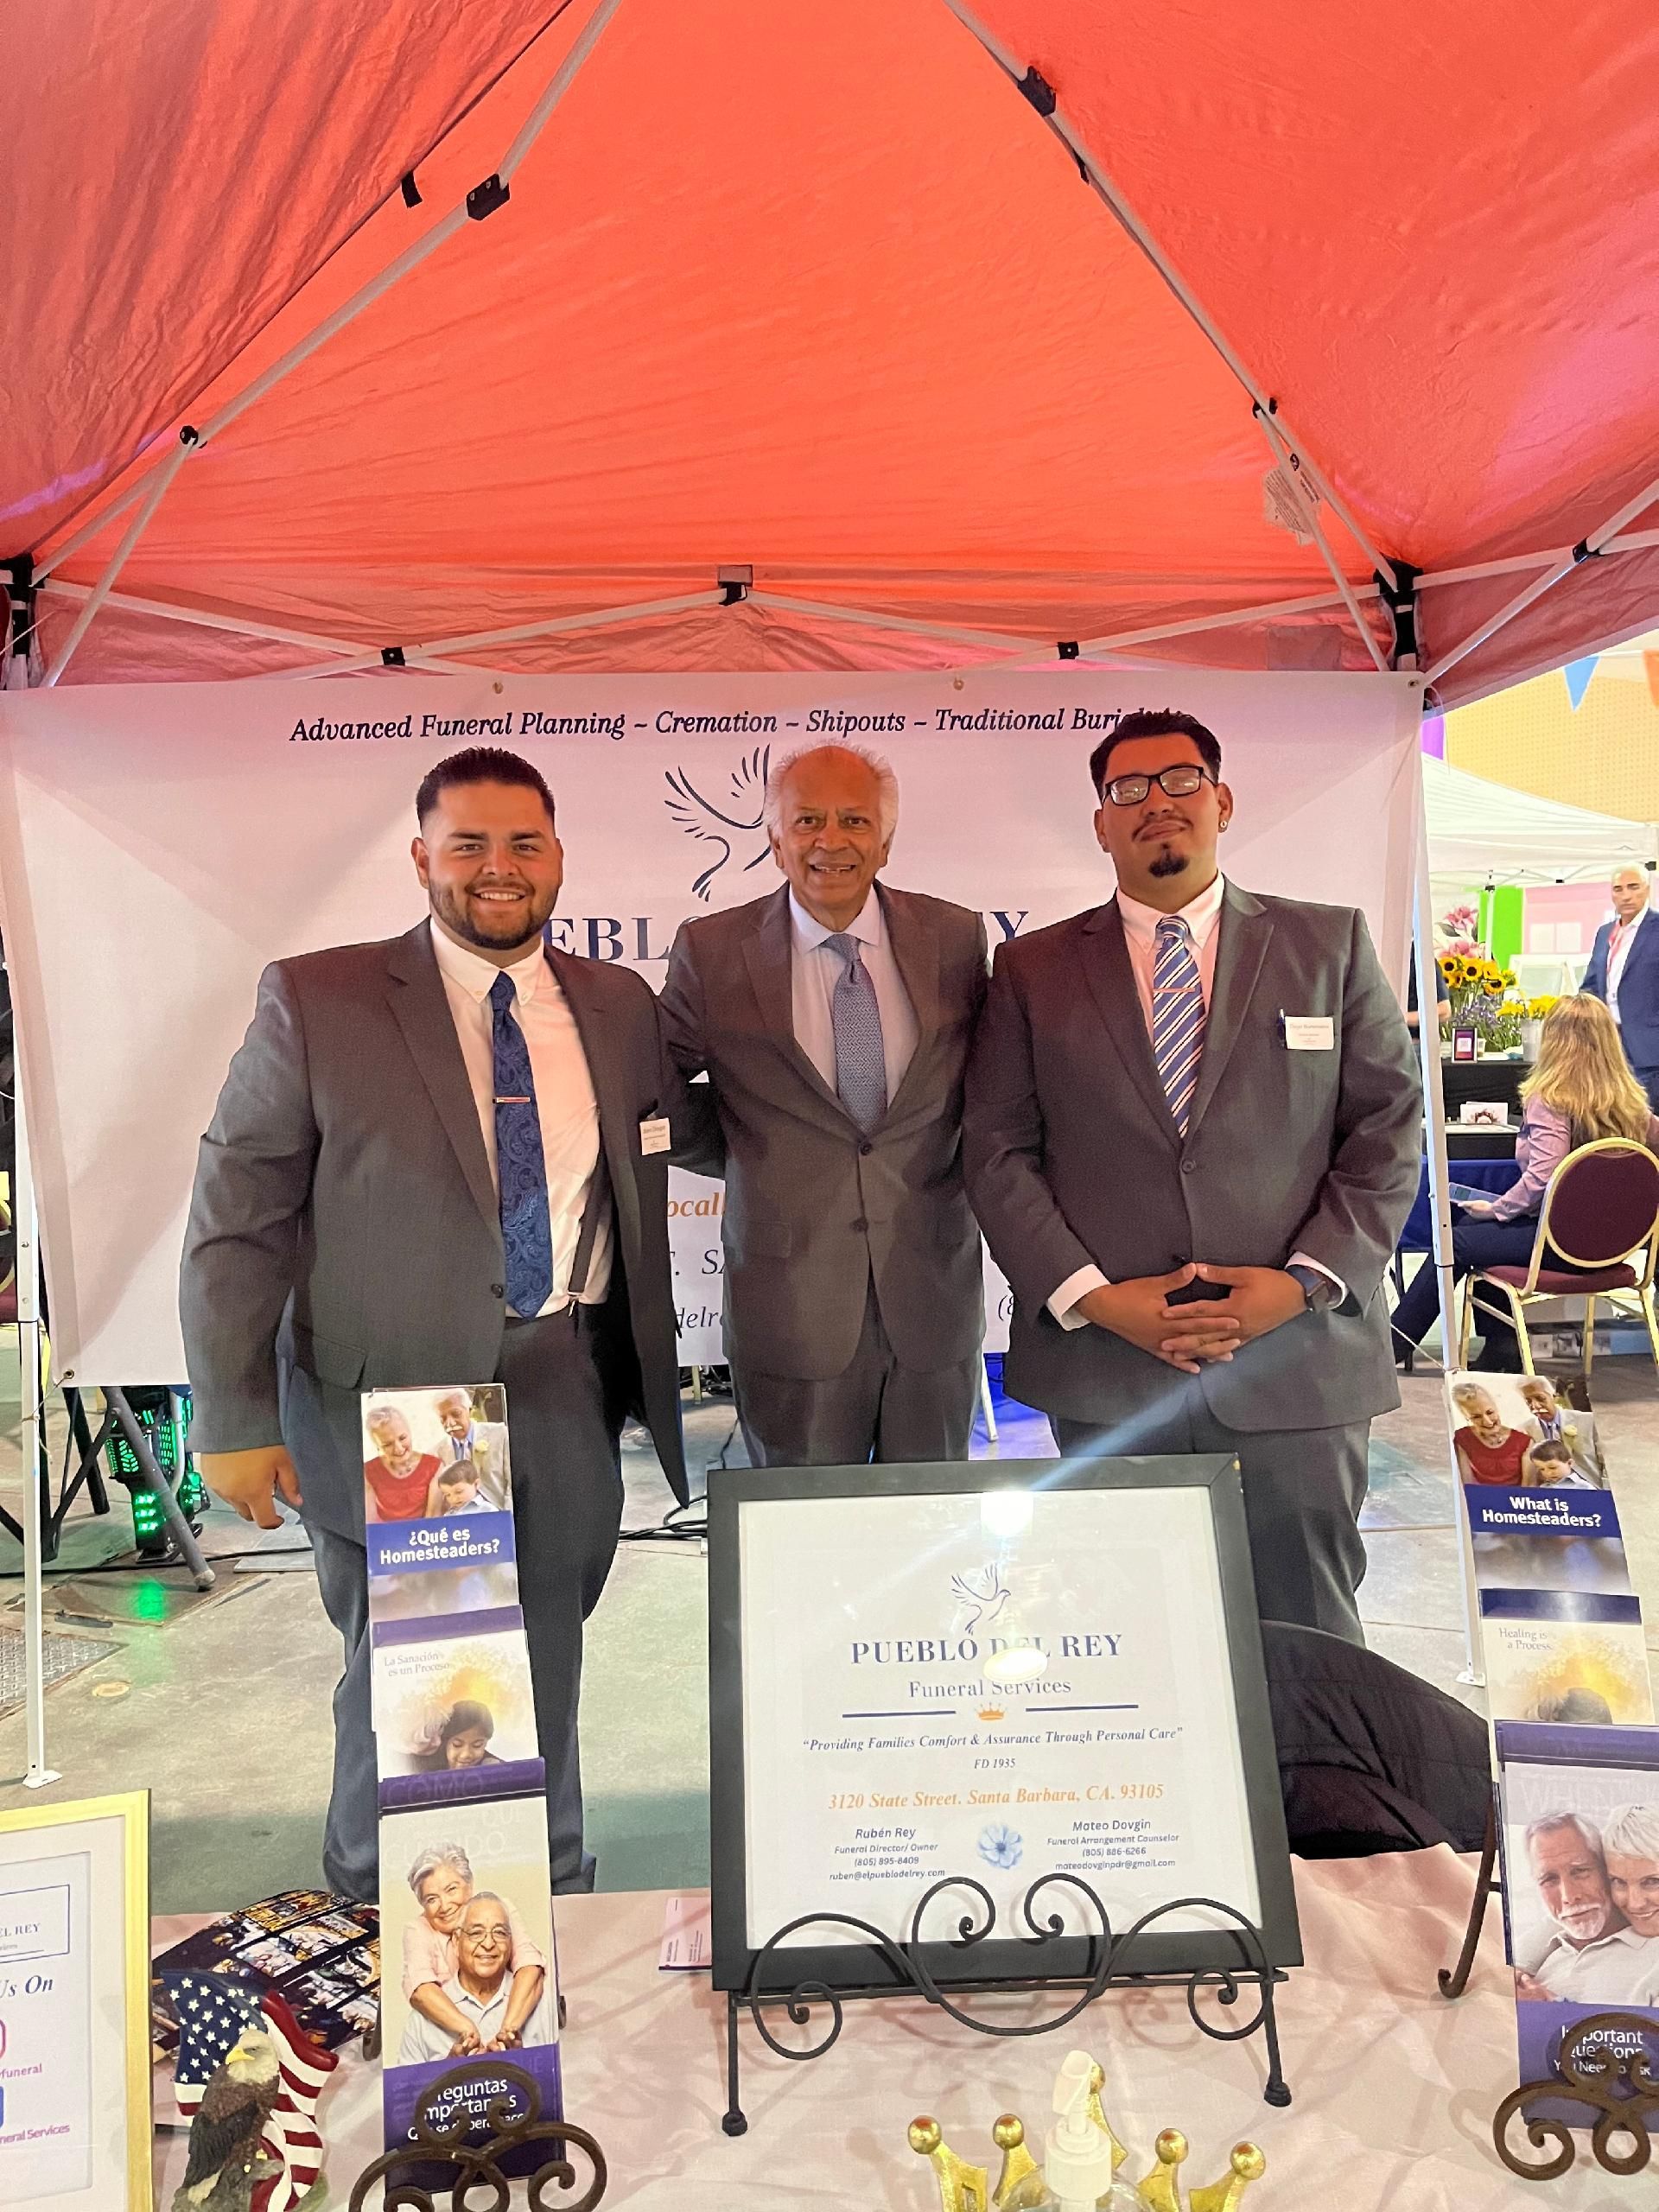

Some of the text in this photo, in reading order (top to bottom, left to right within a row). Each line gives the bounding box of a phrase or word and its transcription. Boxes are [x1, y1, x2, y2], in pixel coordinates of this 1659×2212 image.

[289, 715, 412, 741] Advanced
[421, 712, 512, 737] Funeral
[519, 710, 626, 740] Planning
[655, 710, 777, 734] Cremation
[806, 709, 906, 738] Shipouts
[936, 709, 1064, 731] Traditional
[1071, 709, 1122, 730] Buri
[543, 915, 702, 961] EBL
[1509, 1496, 1569, 1512] What is
[1482, 1509, 1602, 1528] Homesteaders?
[409, 1528, 471, 1546] ¿Qué es
[380, 1538, 500, 1565] Homesteaders?
[1498, 1627, 1548, 1642] Healing is
[851, 1637, 978, 1664] PUEBLO
[1060, 1633, 1122, 1657] REY
[1516, 1639, 1554, 1650] Process
[385, 1651, 439, 1667] La Sanación
[400, 1667, 413, 1675] un
[415, 1662, 450, 1674] Proceso
[909, 1678, 1071, 1699] Funeral Services
[868, 1734, 916, 1750] Families
[918, 1733, 967, 1748] Comfort
[970, 1733, 981, 1745] &
[983, 1732, 1041, 1745] Assurance
[1046, 1730, 1093, 1745] Through
[1096, 1728, 1145, 1742] Personal
[975, 1757, 1016, 1770] FD 1935
[828, 1793, 865, 1810] 3120
[869, 1793, 909, 1808] State
[967, 1789, 1011, 1805] Santa
[1016, 1786, 1081, 1804] Barbara,
[1120, 1783, 1164, 1800] 93105
[855, 1827, 916, 1840] Rubén Rey
[1072, 1818, 1151, 1832] Mateo Dovgin
[834, 1845, 868, 1853] Funeral
[911, 1843, 939, 1852] Owner
[1046, 1834, 1179, 1846] Funeral Arrangement Counselor
[1083, 1848, 1104, 1858] (805)
[855, 1858, 877, 1867] (805)
[829, 1869, 945, 1881] ruben@elpueblodelrey.com
[15, 1922, 41, 1936] REY
[25, 1974, 54, 1994] On
[1561, 2024, 1644, 2044] Iportant
[0, 2062, 42, 2080] funeral
[437, 2078, 508, 2103] eguntas
[0, 2124, 70, 2144] neral Services
